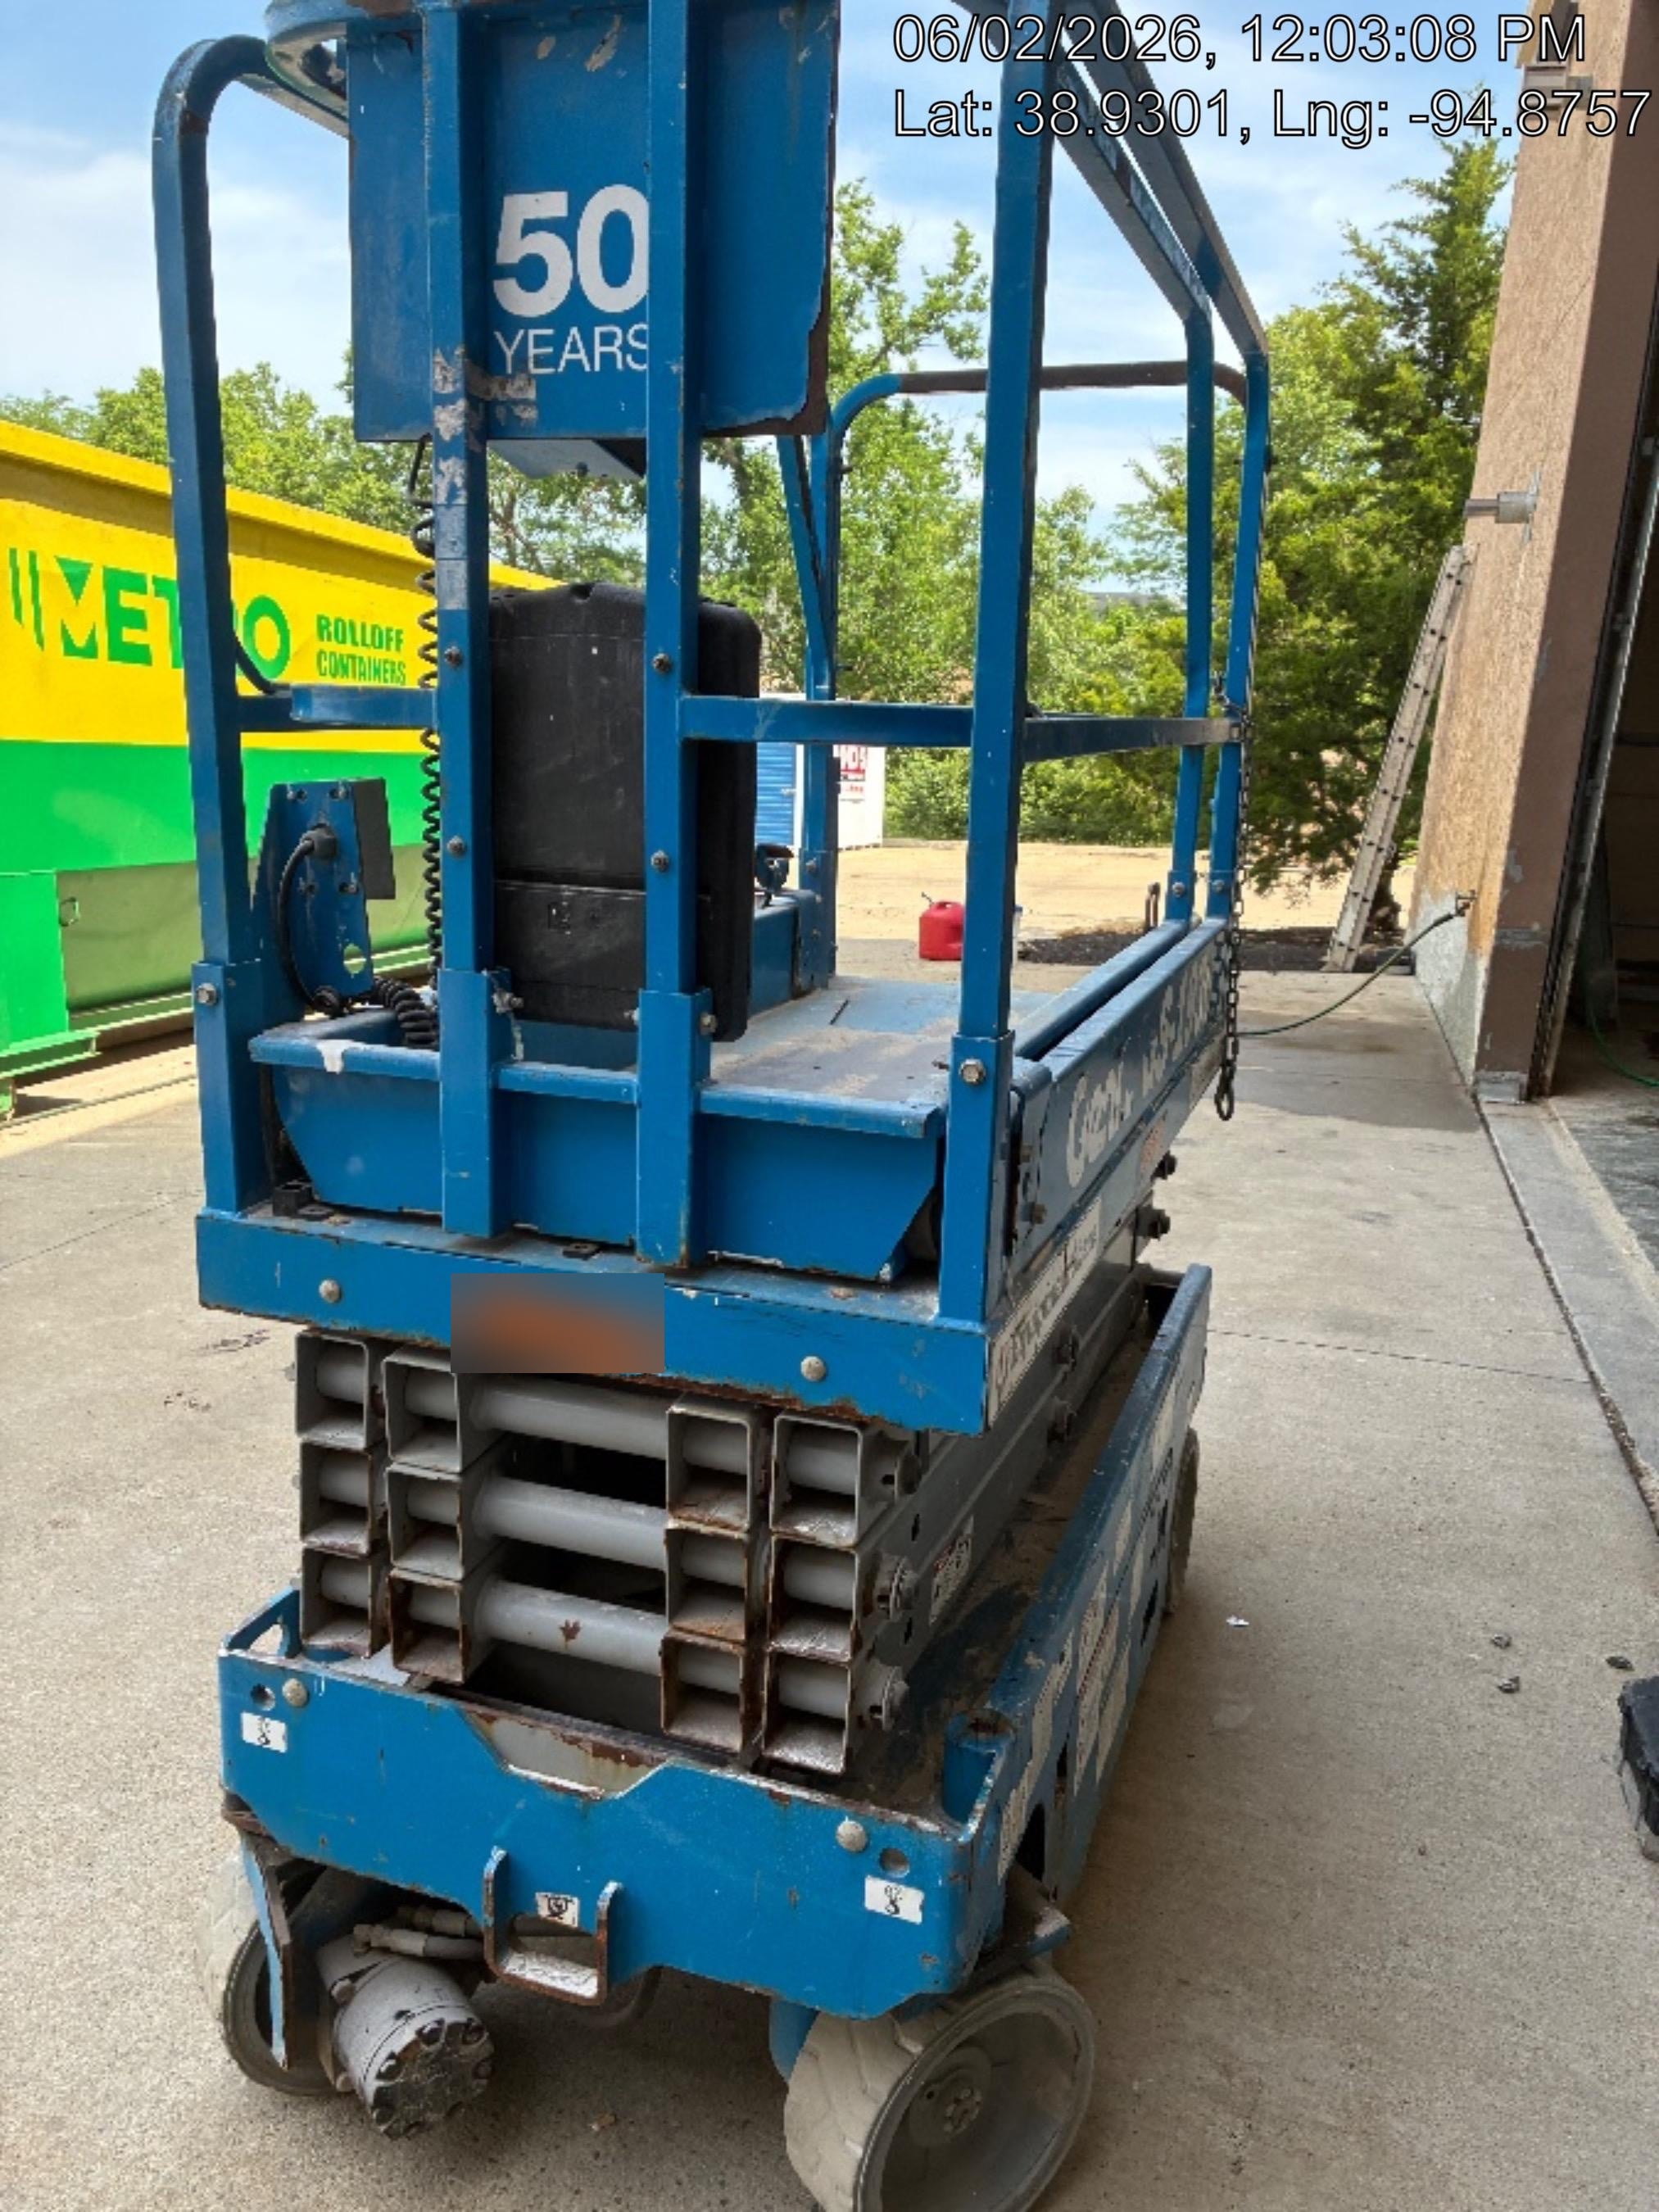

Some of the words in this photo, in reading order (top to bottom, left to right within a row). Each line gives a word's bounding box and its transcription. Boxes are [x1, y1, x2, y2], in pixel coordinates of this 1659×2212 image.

[493, 184, 649, 318] 50
[494, 324, 648, 374] YEARS
[54, 555, 291, 680] METO
[316, 614, 404, 652] ROLLOFF
[316, 649, 406, 686] CONTAINERS
